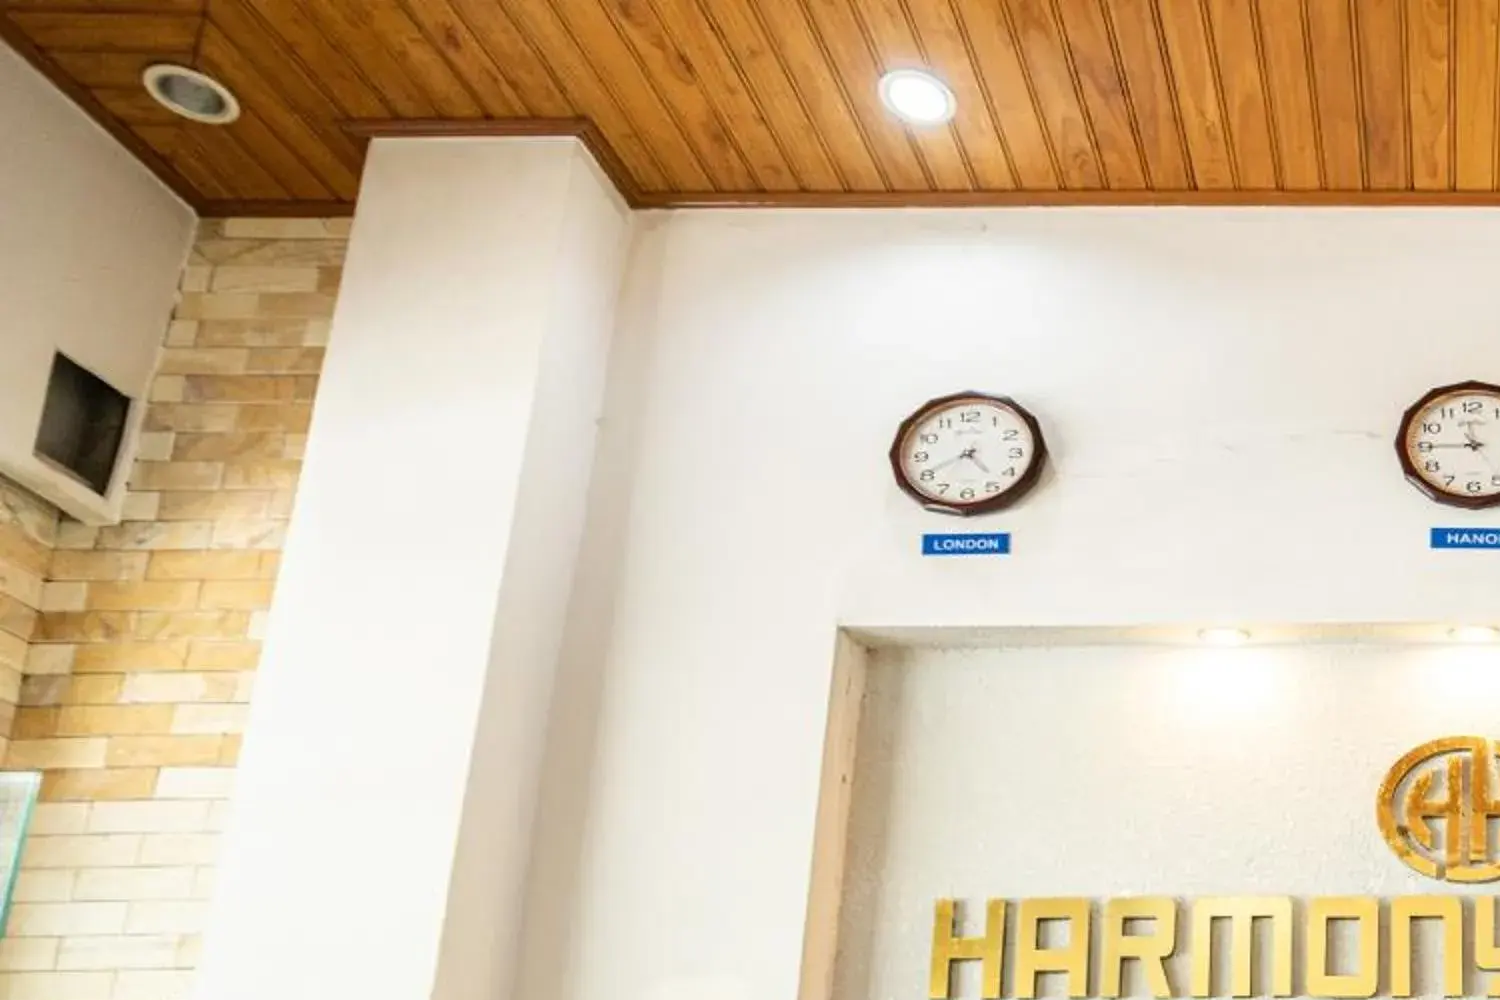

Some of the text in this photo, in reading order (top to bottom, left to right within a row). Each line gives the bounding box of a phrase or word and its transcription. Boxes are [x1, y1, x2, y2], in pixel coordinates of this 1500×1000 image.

[1441, 407, 1455, 420] 11
[1462, 401, 1484, 414] 12
[959, 410, 981, 423] 12
[938, 418, 951, 429] 11
[1422, 422, 1442, 435] 10
[919, 432, 939, 444] 10
[1001, 429, 1019, 442] 2
[1008, 447, 1023, 459] 3
[1417, 441, 1434, 453] 9
[914, 451, 929, 463] 9
[1001, 466, 1016, 478] 4
[1424, 459, 1441, 473] 8
[919, 469, 935, 482] 8
[1443, 474, 1456, 487] 7
[936, 482, 951, 495] 7
[959, 487, 975, 500] 6
[985, 481, 1001, 493] 5
[1465, 480, 1482, 494] 6
[933, 538, 999, 550] LONDON
